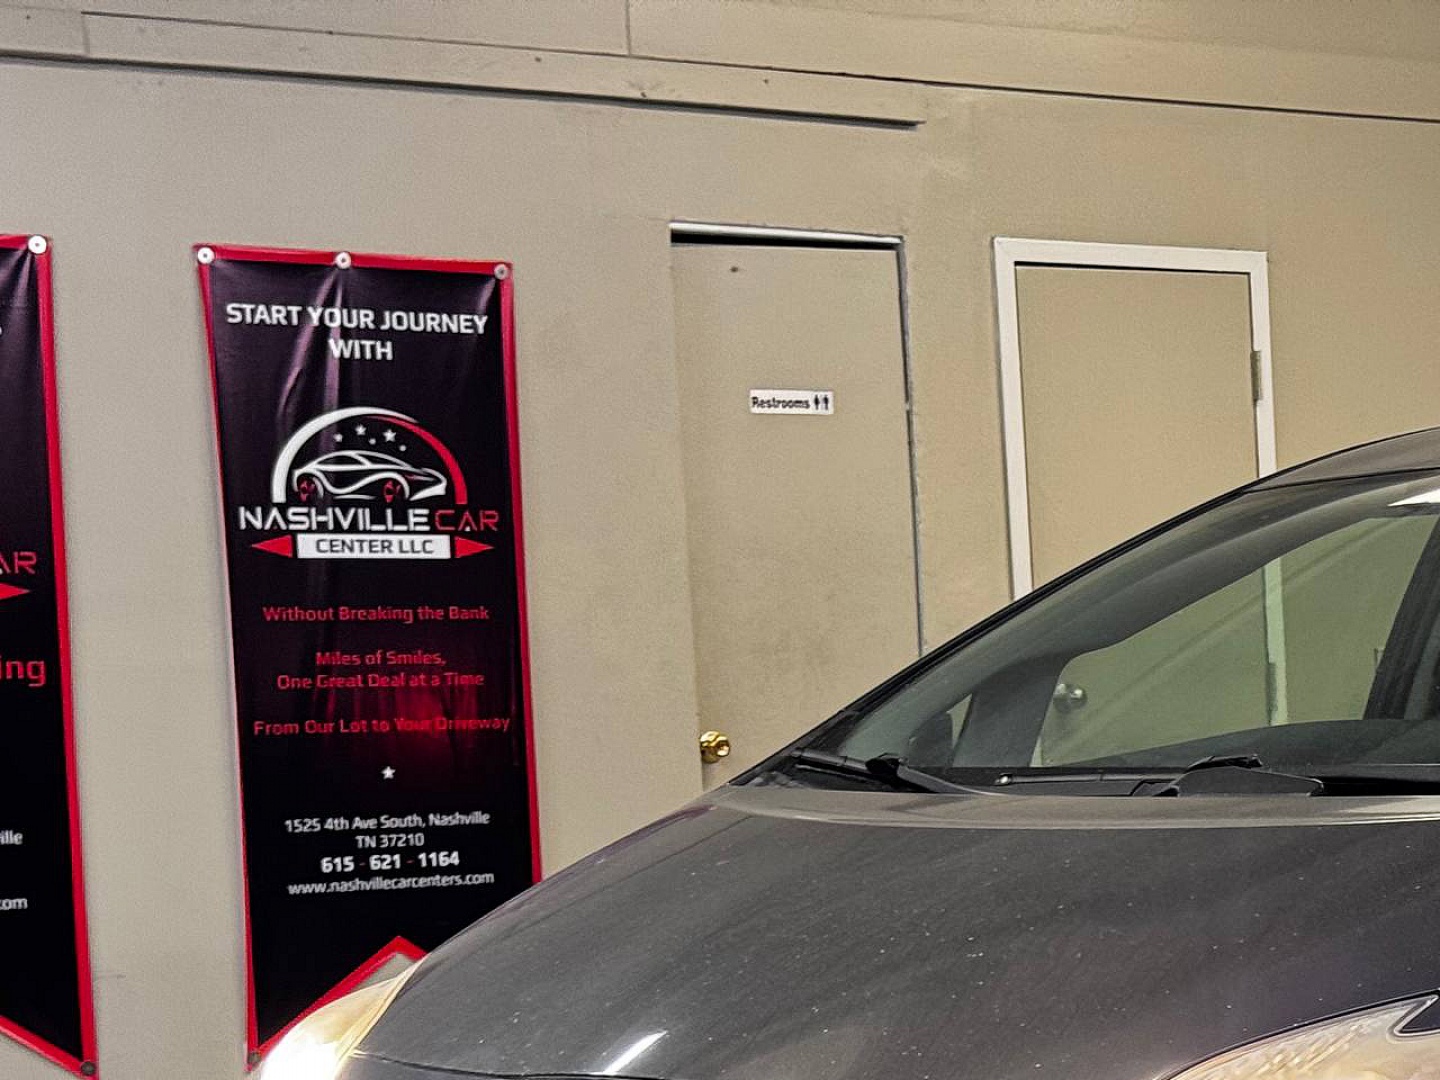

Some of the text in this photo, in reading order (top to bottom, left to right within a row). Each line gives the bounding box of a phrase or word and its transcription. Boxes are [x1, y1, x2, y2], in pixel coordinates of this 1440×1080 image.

[226, 302, 489, 335] START YOUR JOURNEY
[327, 337, 394, 361] WITH
[751, 396, 811, 409] Restrooms
[239, 506, 500, 532] NASHVILLE CAR
[315, 538, 434, 555] CENTER LLC
[0, 551, 37, 575] AR
[262, 606, 490, 624] Without Breaking the Bank
[315, 650, 447, 666] Miles of Smiles,
[277, 672, 485, 690] One Great Deal at a Time
[253, 716, 511, 736] From Our Lot to Your Driveway
[284, 811, 491, 833] 1525 4th Ave South, Nashville
[355, 832, 426, 849] TN 37210
[320, 856, 355, 873] 615
[368, 853, 401, 871] 621
[417, 850, 460, 868] 1164
[287, 872, 495, 895] www.nashvillecarcenters.com
